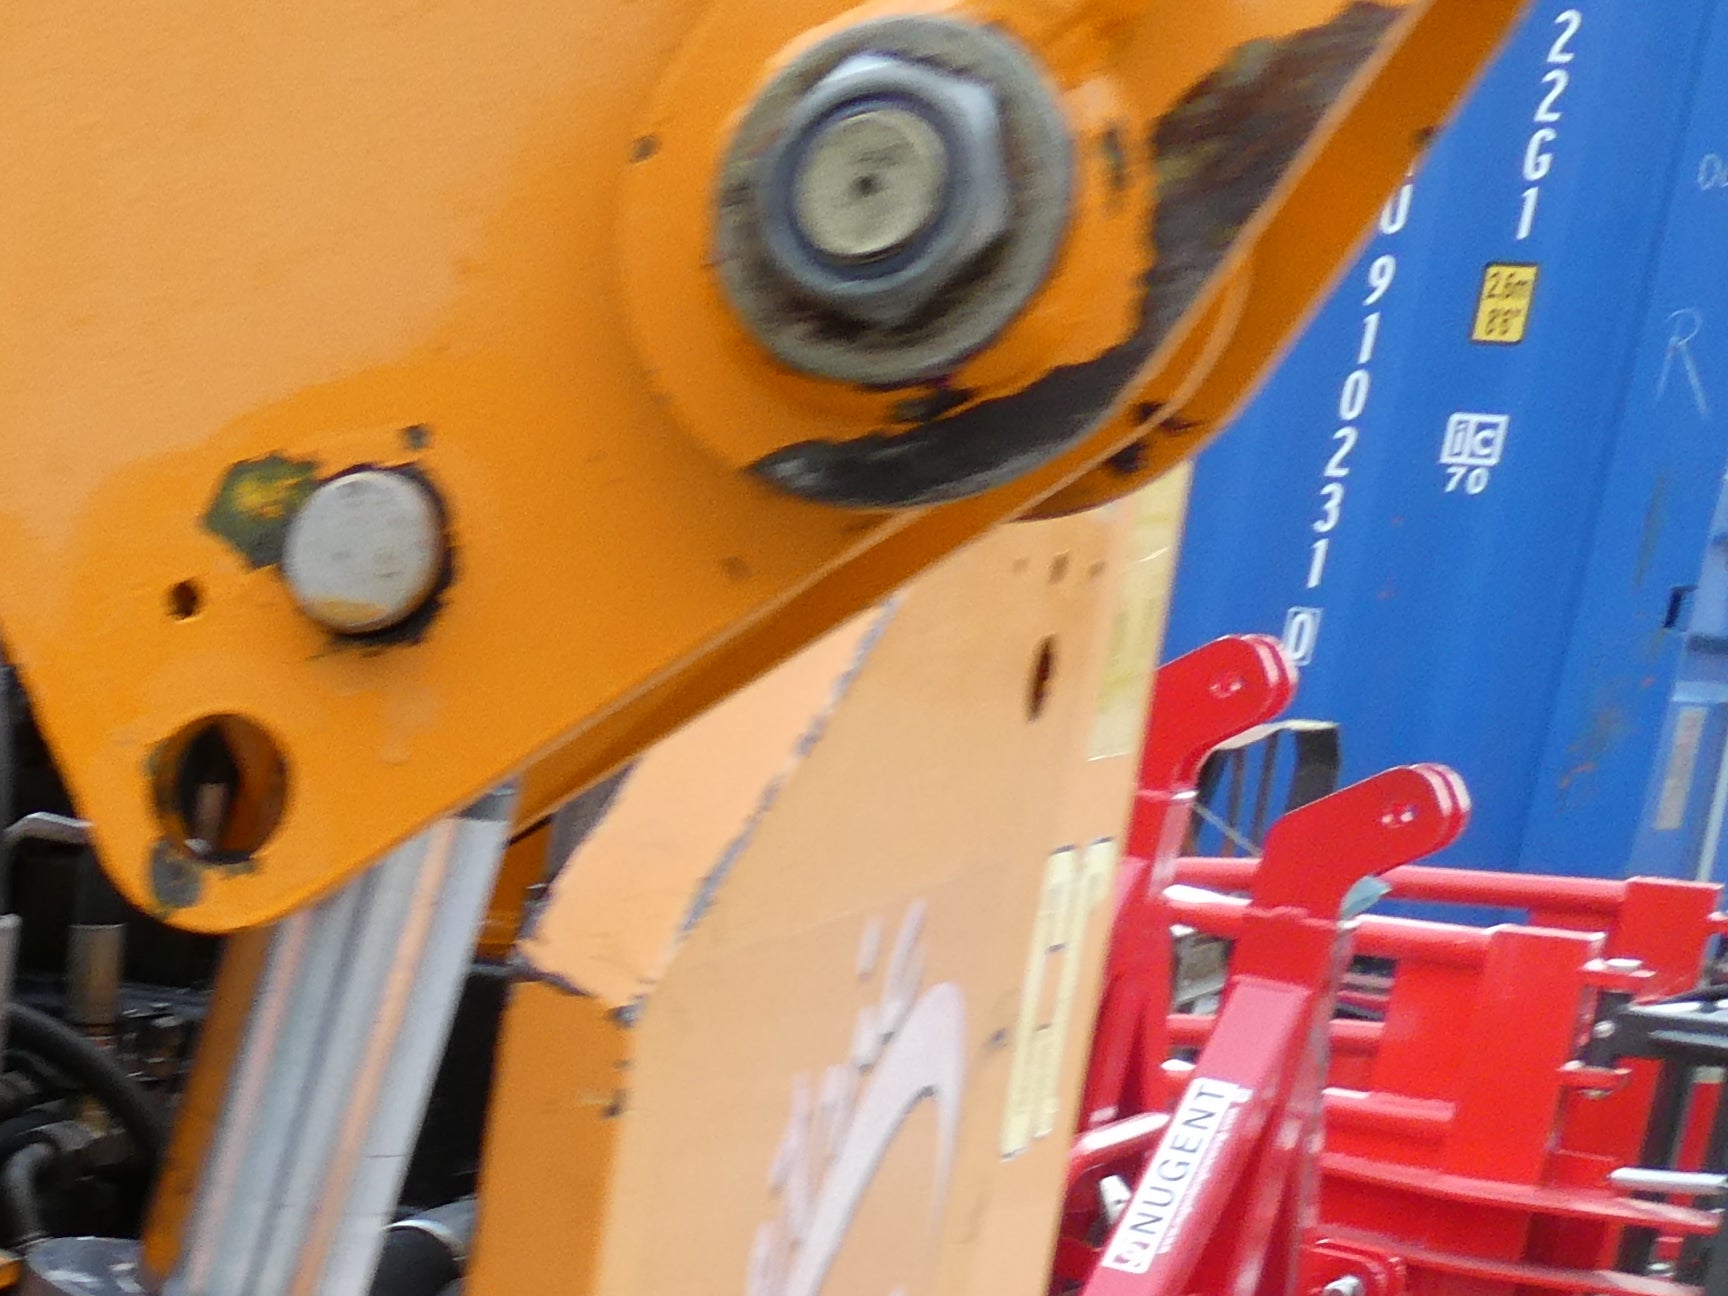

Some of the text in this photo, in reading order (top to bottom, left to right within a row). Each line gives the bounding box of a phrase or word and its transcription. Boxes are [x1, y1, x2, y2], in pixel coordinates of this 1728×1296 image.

[1516, 9, 1582, 240] 22G1
[1444, 465, 1492, 495] 70
[1129, 1082, 1225, 1236] NUGENT
